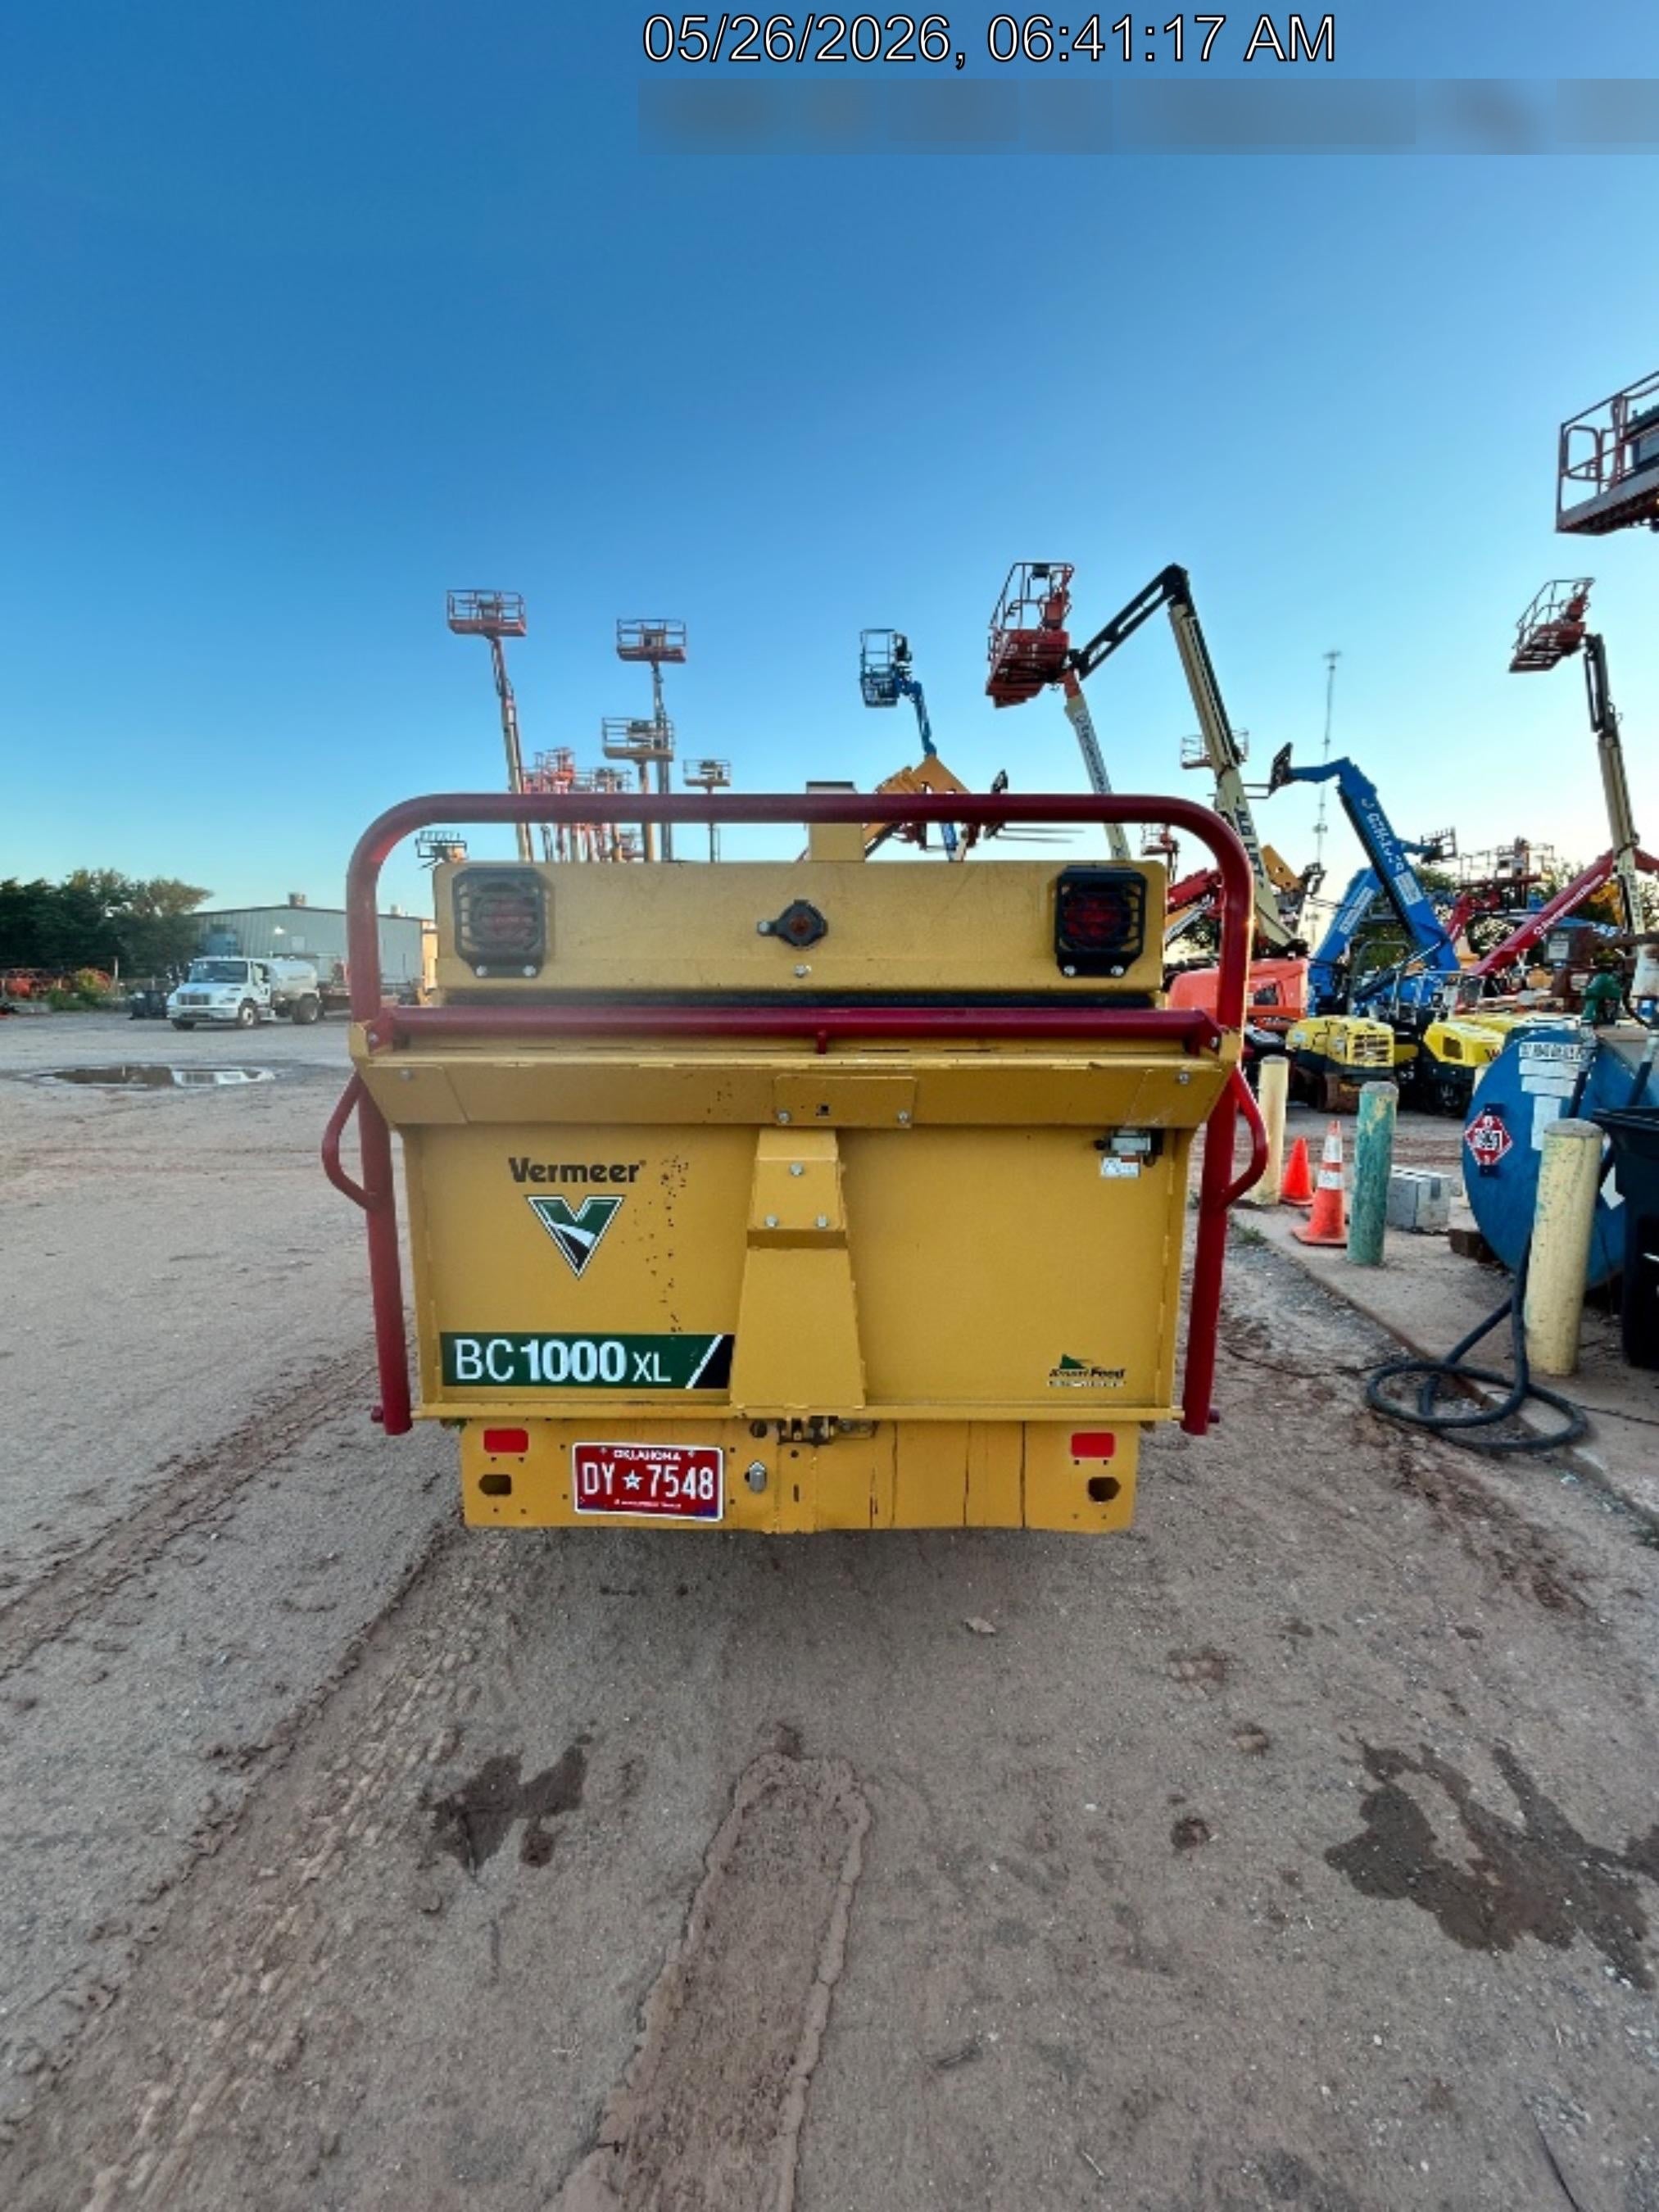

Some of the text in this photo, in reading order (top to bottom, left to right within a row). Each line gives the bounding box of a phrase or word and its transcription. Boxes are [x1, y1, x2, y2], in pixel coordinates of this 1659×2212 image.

[508, 1157, 640, 1183] Vermeer
[614, 1449, 682, 1461] OKLAHOMA
[582, 1462, 714, 1500] DY 7548
